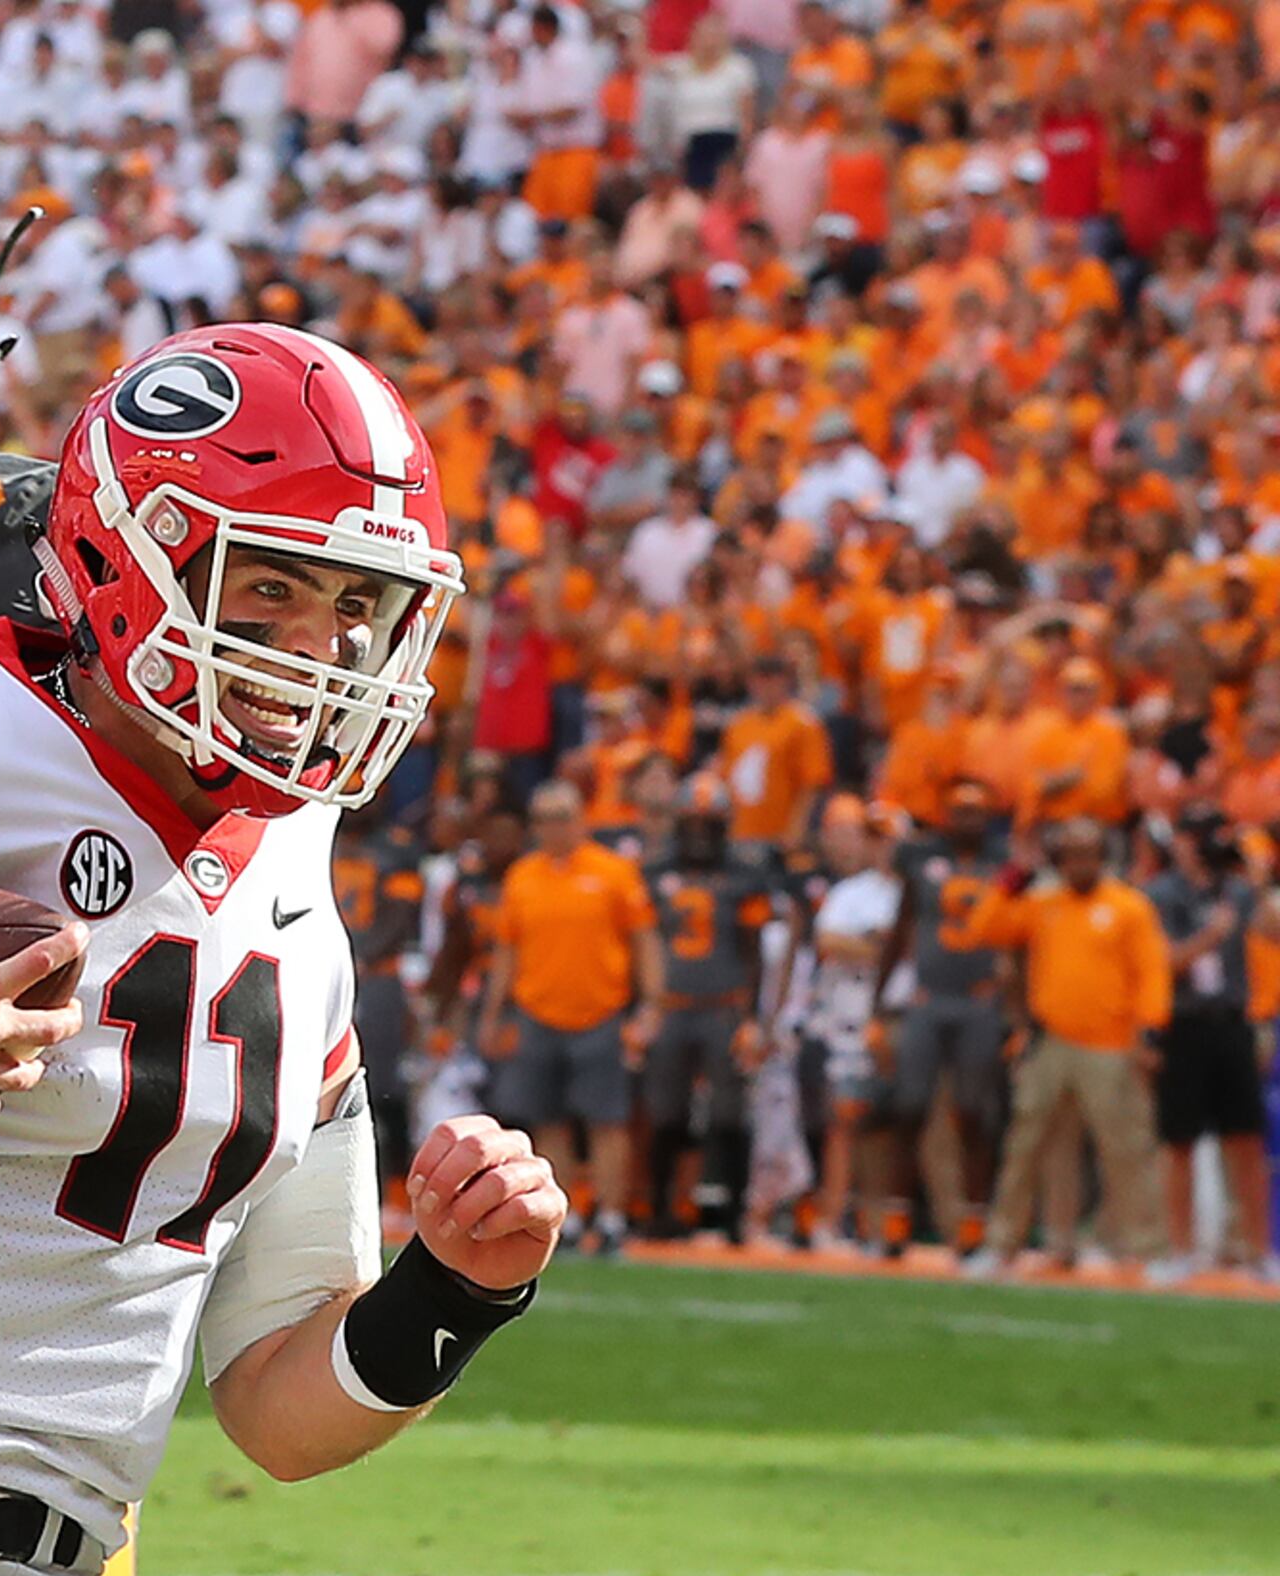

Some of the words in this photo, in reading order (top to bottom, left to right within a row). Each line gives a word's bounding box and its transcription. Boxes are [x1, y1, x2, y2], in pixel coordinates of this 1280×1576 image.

[112, 354, 239, 439] G
[363, 519, 415, 544] DAWGS
[66, 836, 130, 914] SEC
[188, 855, 226, 889] G
[54, 931, 284, 1255] 11
